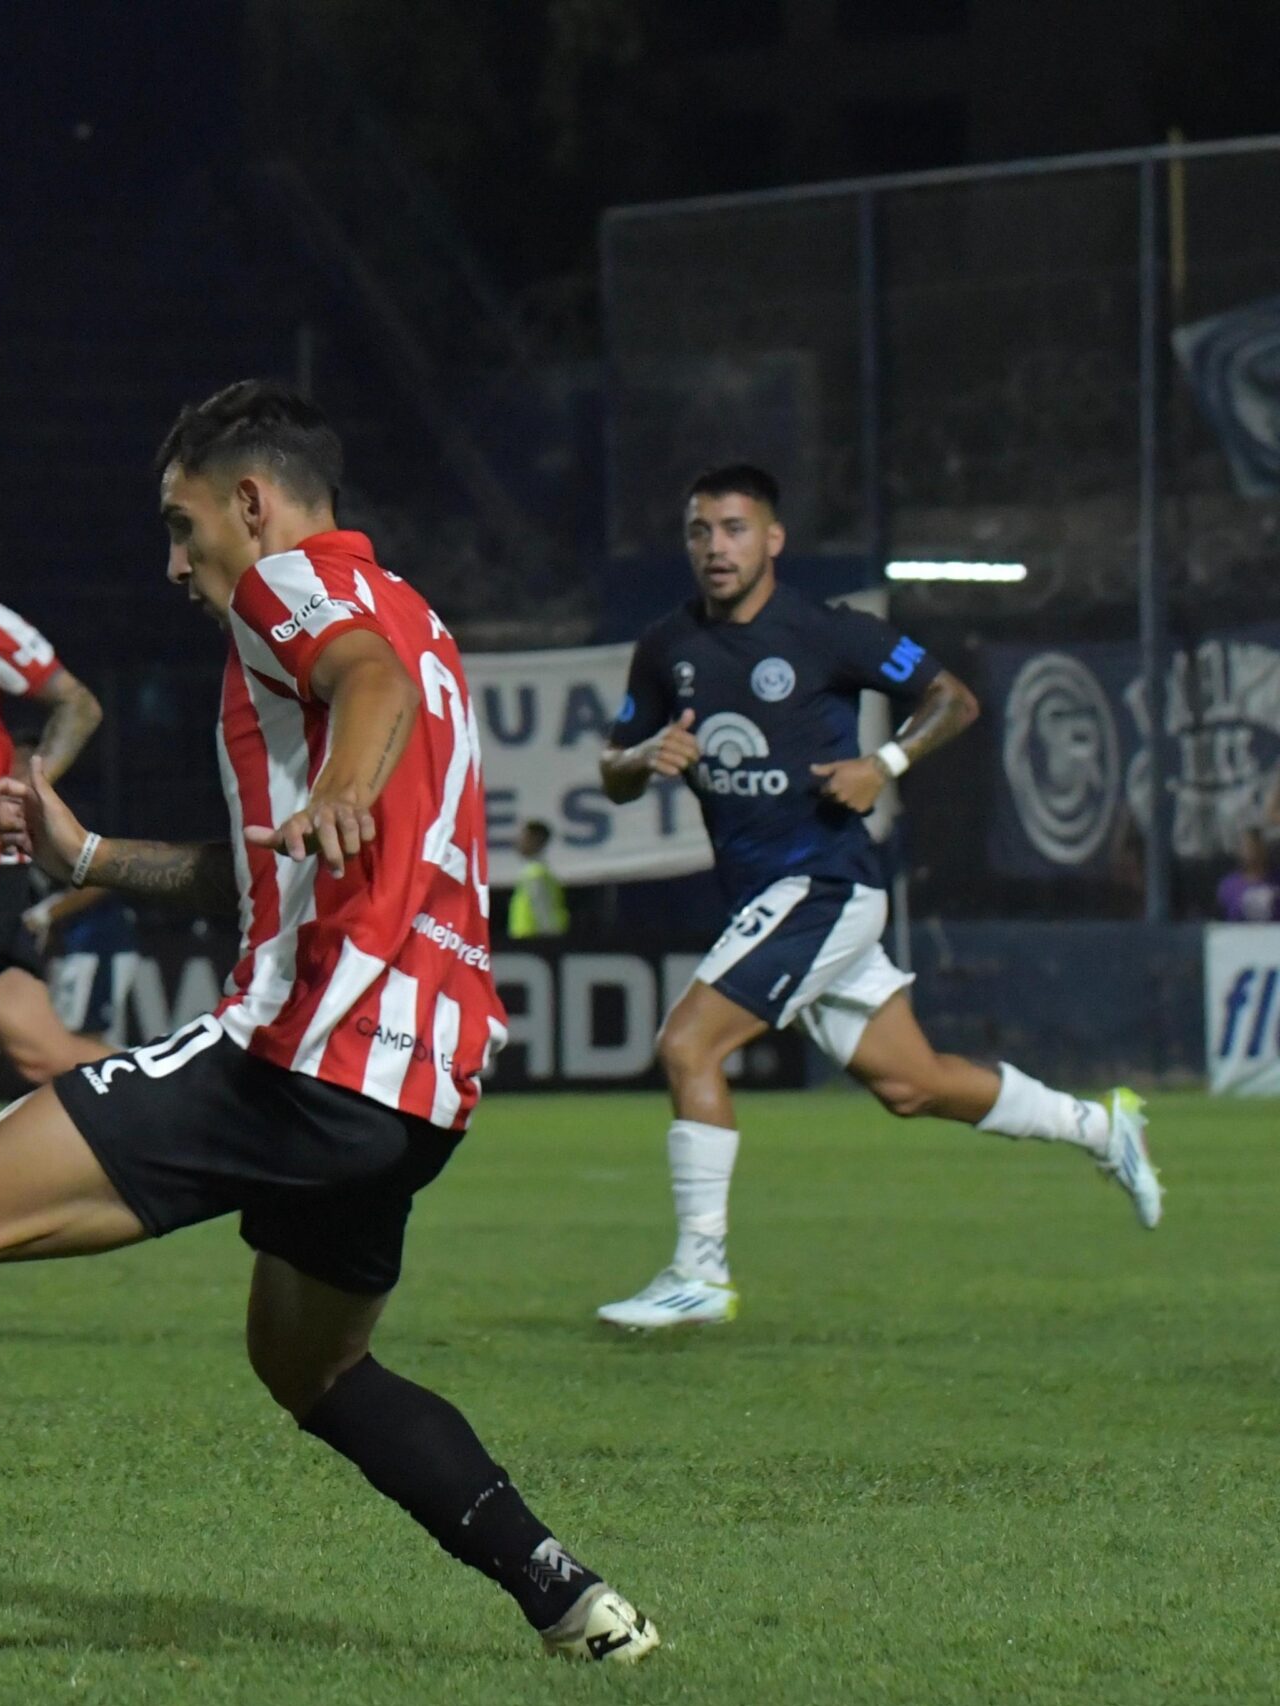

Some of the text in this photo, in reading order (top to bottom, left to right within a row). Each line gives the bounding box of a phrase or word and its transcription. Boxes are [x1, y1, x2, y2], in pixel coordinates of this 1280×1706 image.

[420, 651, 489, 918] 2
[128, 1013, 223, 1078] 0
[1221, 968, 1280, 1058] fl
